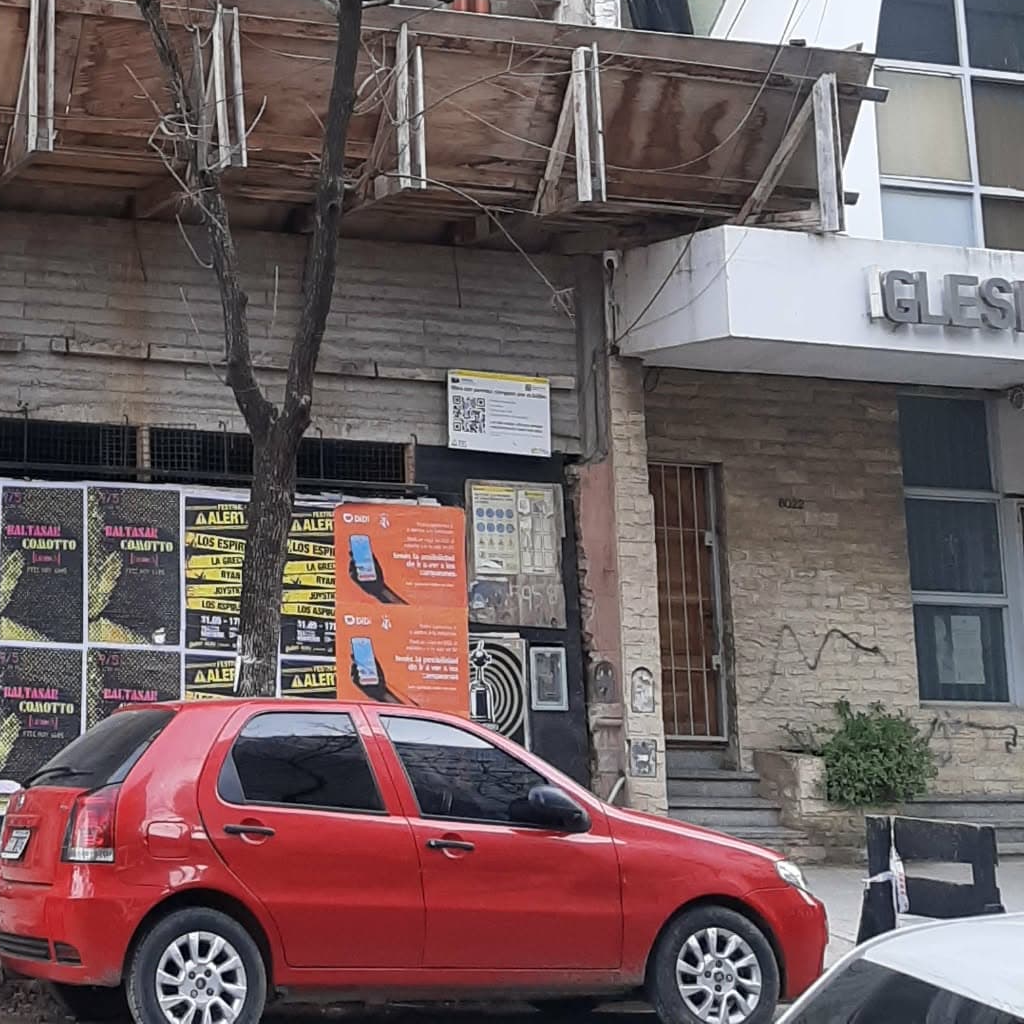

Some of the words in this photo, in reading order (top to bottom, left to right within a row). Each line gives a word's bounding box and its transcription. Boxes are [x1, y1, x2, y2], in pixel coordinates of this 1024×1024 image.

[7, 525, 61, 537] BALTASAR
[105, 526, 158, 539] BALTASAR
[22, 538, 77, 551] COMOTTO
[121, 539, 174, 553] COMOTTO
[197, 535, 215, 547] LOS
[293, 541, 309, 554] LOS
[211, 557, 220, 565] LA
[202, 599, 215, 609] LOS
[297, 605, 311, 614] LOS
[4, 686, 58, 700] BALTASAR
[103, 688, 158, 702] BALTASAR
[19, 701, 74, 714] COMOTTO
